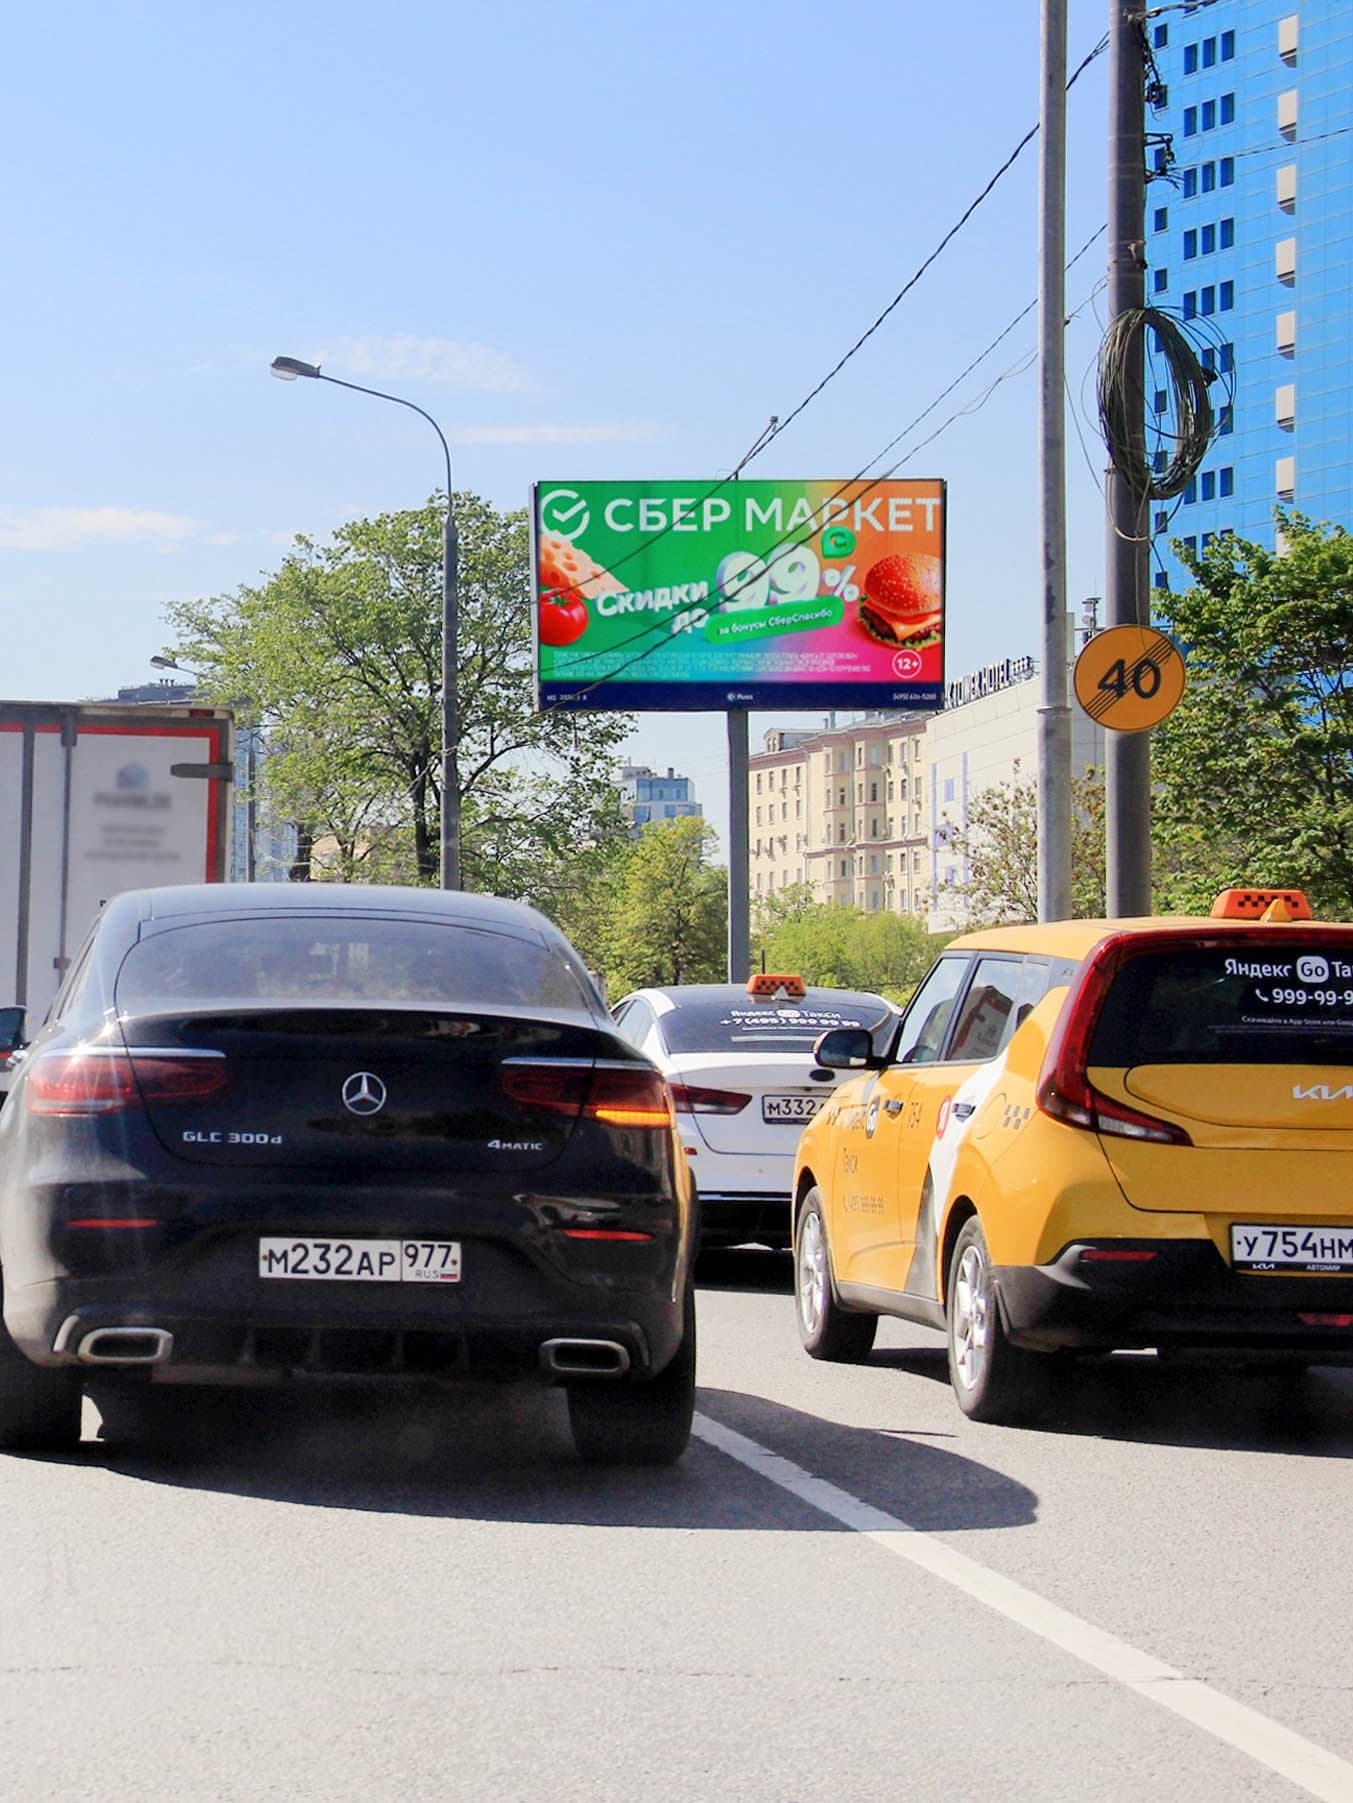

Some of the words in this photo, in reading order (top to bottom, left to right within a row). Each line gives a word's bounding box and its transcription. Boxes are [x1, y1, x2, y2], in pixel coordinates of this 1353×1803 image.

[603, 497, 731, 532] СБЕР
[745, 497, 942, 533] МАРКЕТ
[596, 580, 708, 617] Скидки
[671, 607, 710, 635] до
[767, 608, 833, 628] СберСпасибо
[896, 657, 920, 671] 12+
[1097, 658, 1162, 699] 40
[1224, 958, 1293, 979] Яндекс
[1300, 961, 1326, 978] Go
[1331, 960, 1353, 978] Та
[182, 1131, 222, 1143] GLC
[227, 1132, 283, 1145] 300d
[487, 1139, 543, 1151] 4MATIC
[267, 1242, 396, 1276] М232АР
[403, 1243, 453, 1269] 977
[414, 1269, 440, 1279] RUS
